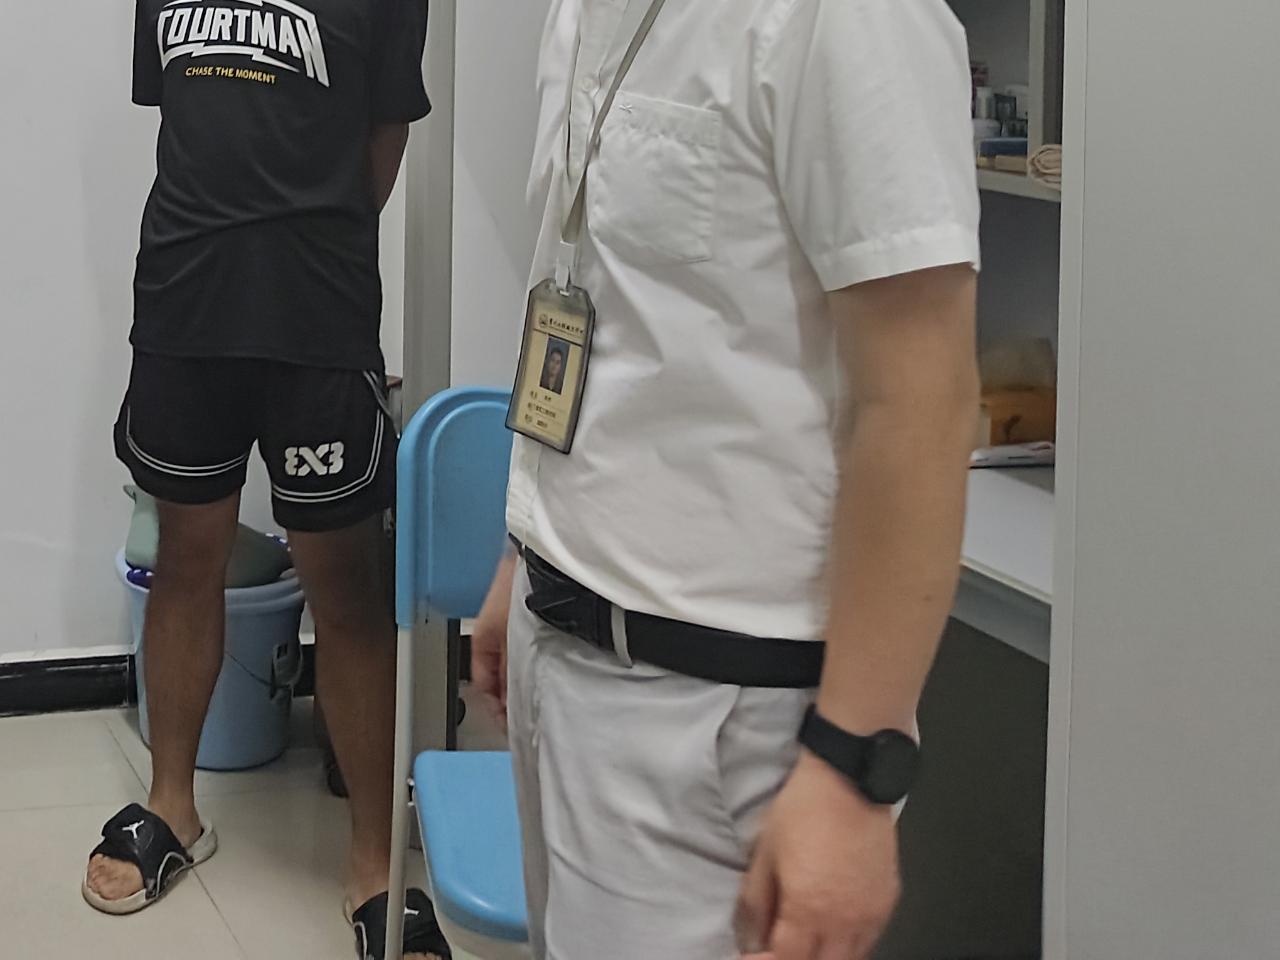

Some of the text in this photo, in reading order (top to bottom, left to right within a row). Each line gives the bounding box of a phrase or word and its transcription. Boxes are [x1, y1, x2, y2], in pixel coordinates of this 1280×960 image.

[157, 4, 330, 87] COURTMAN
[185, 66, 276, 85] CHASE THE MOMENT
